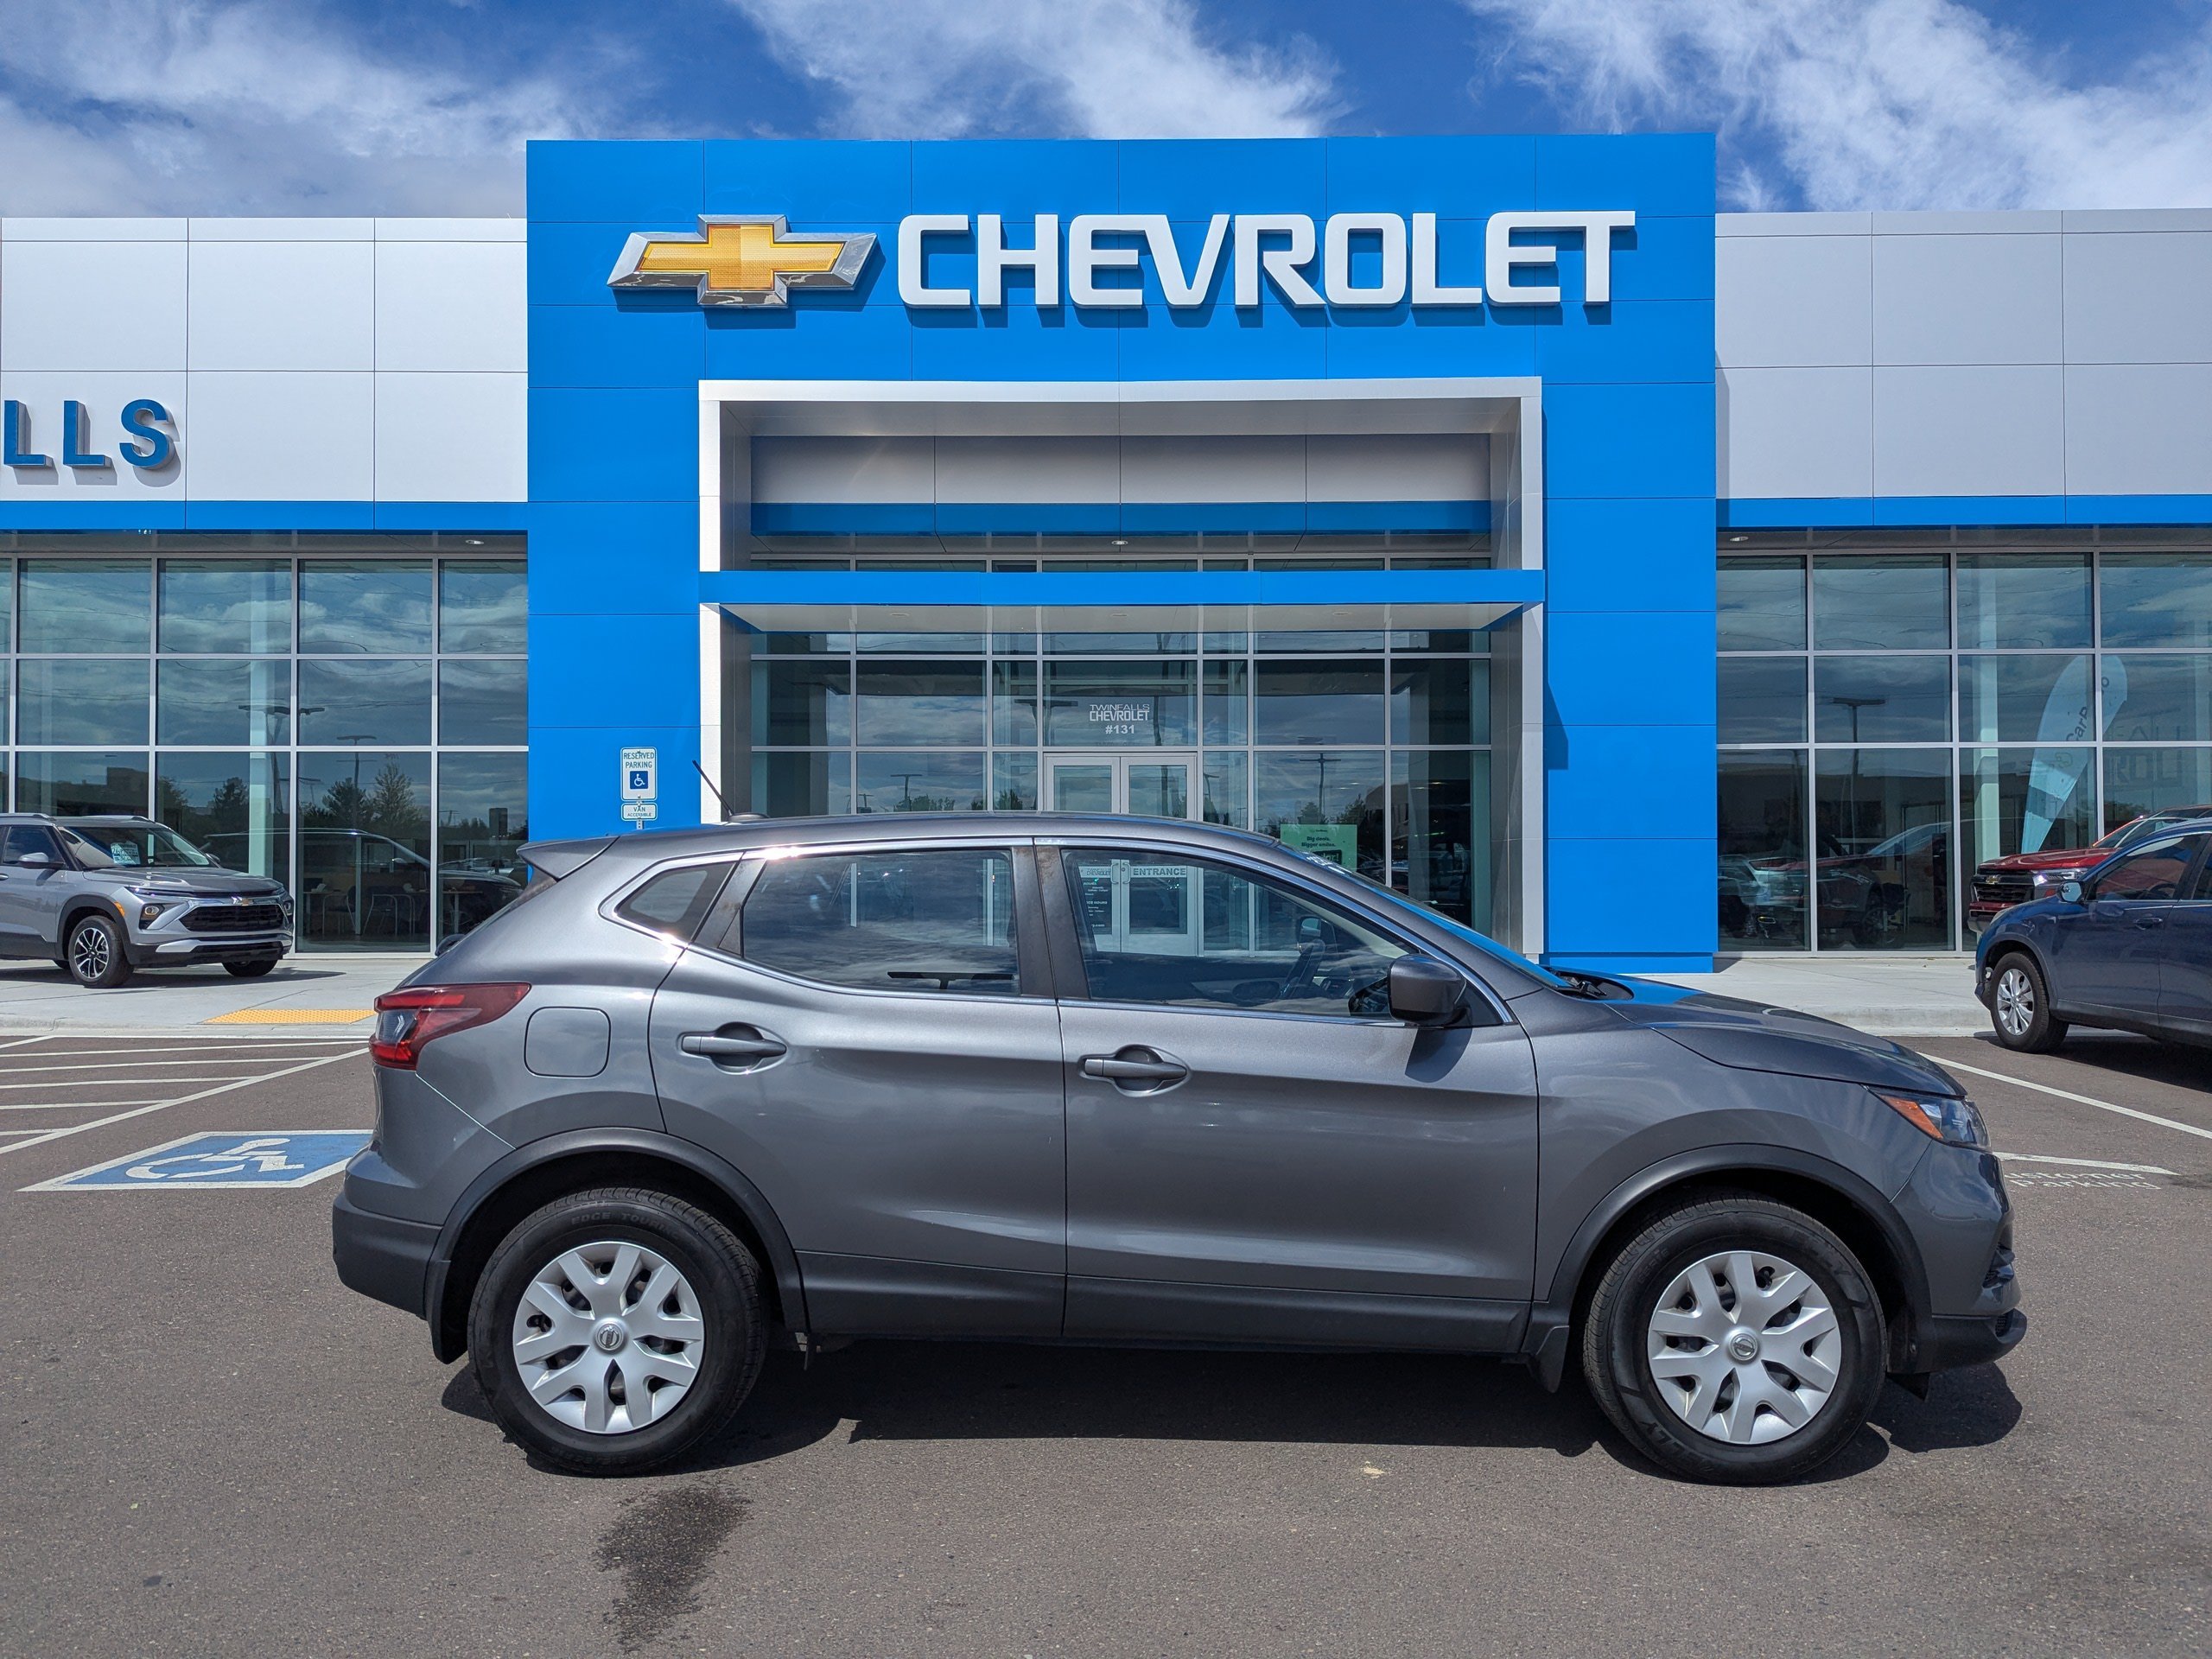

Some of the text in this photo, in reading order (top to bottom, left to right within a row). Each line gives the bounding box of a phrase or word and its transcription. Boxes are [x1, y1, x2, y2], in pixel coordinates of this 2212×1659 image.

[897, 210, 1637, 308] CHEVROLET
[3, 398, 172, 468] LLS
[1089, 710, 1150, 721] CHEVROLET
[1105, 724, 1135, 734] #131
[1133, 868, 1186, 876] ENTRANCE
[571, 1211, 612, 1225] EDGE
